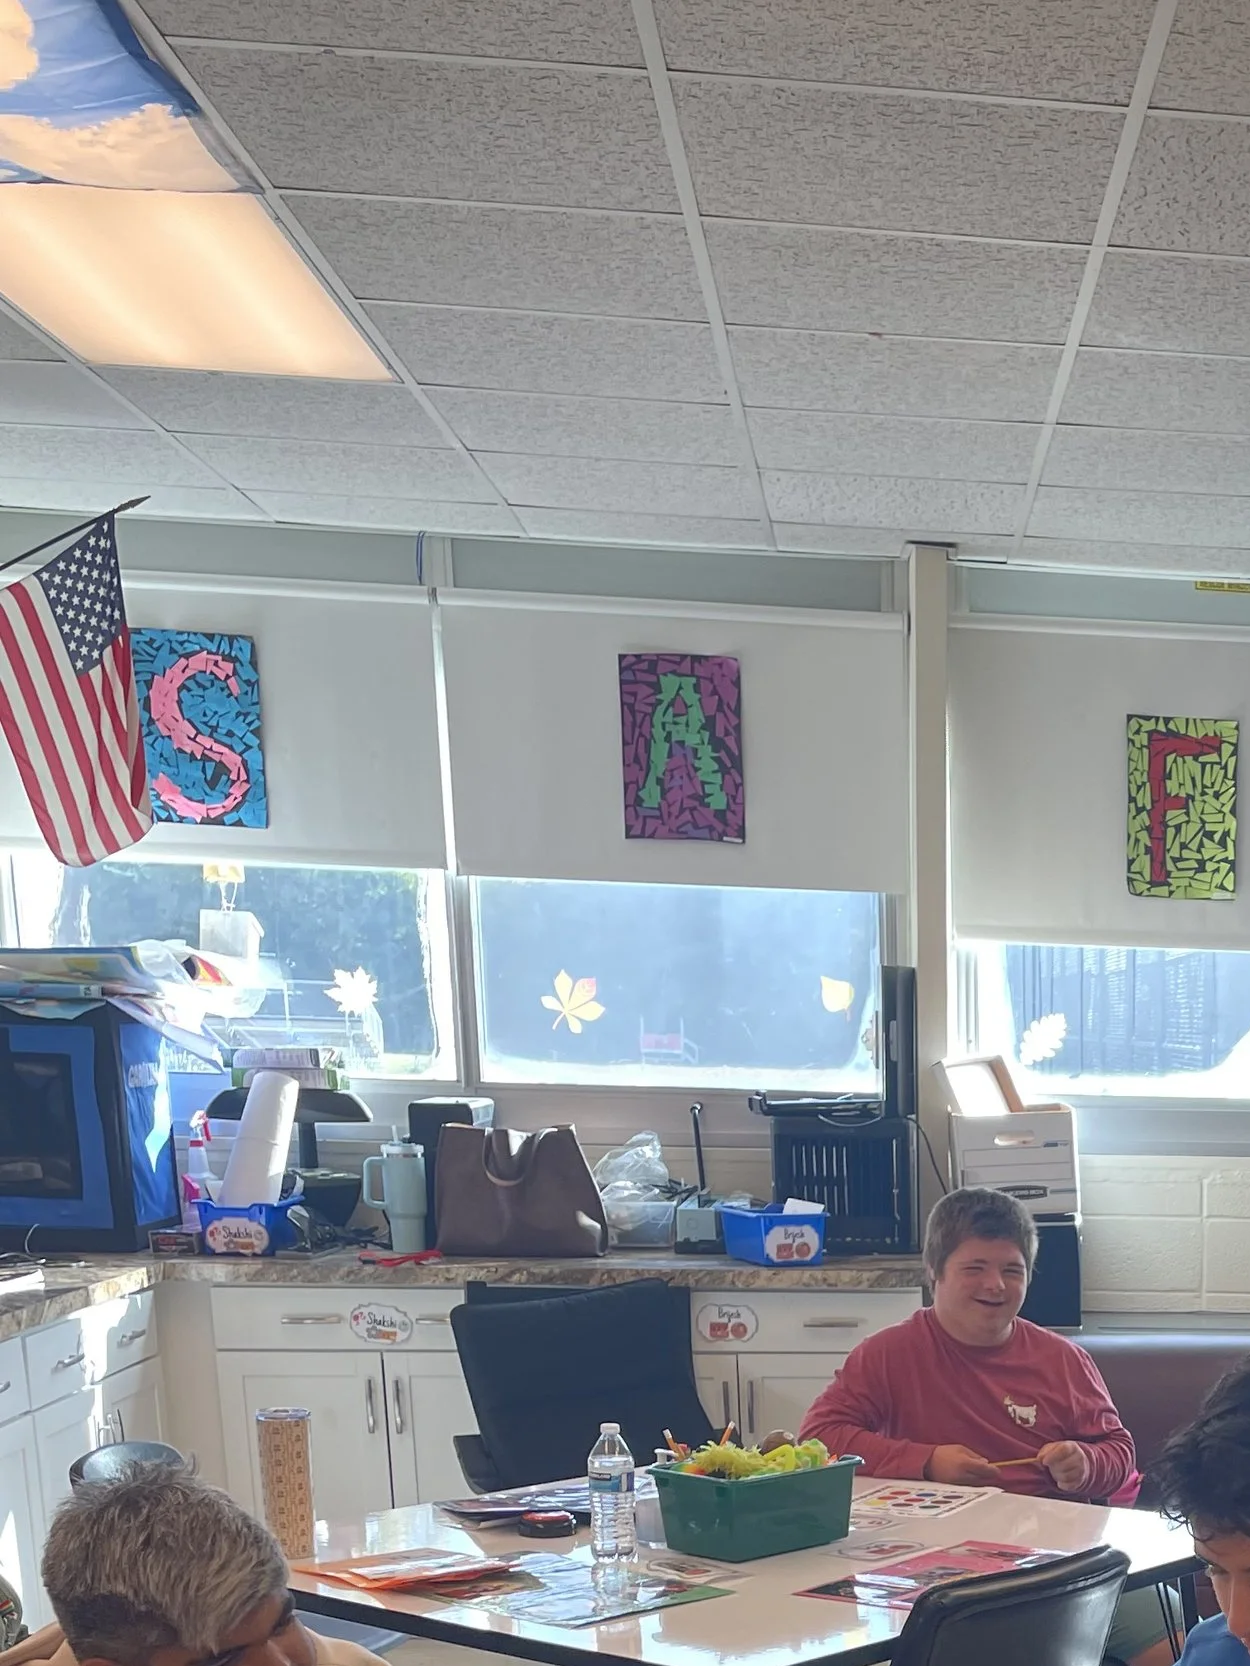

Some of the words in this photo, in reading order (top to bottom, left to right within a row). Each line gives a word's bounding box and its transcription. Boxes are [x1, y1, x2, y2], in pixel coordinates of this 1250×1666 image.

[150, 651, 250, 823] S
[638, 673, 727, 810] A
[1148, 729, 1222, 882] F
